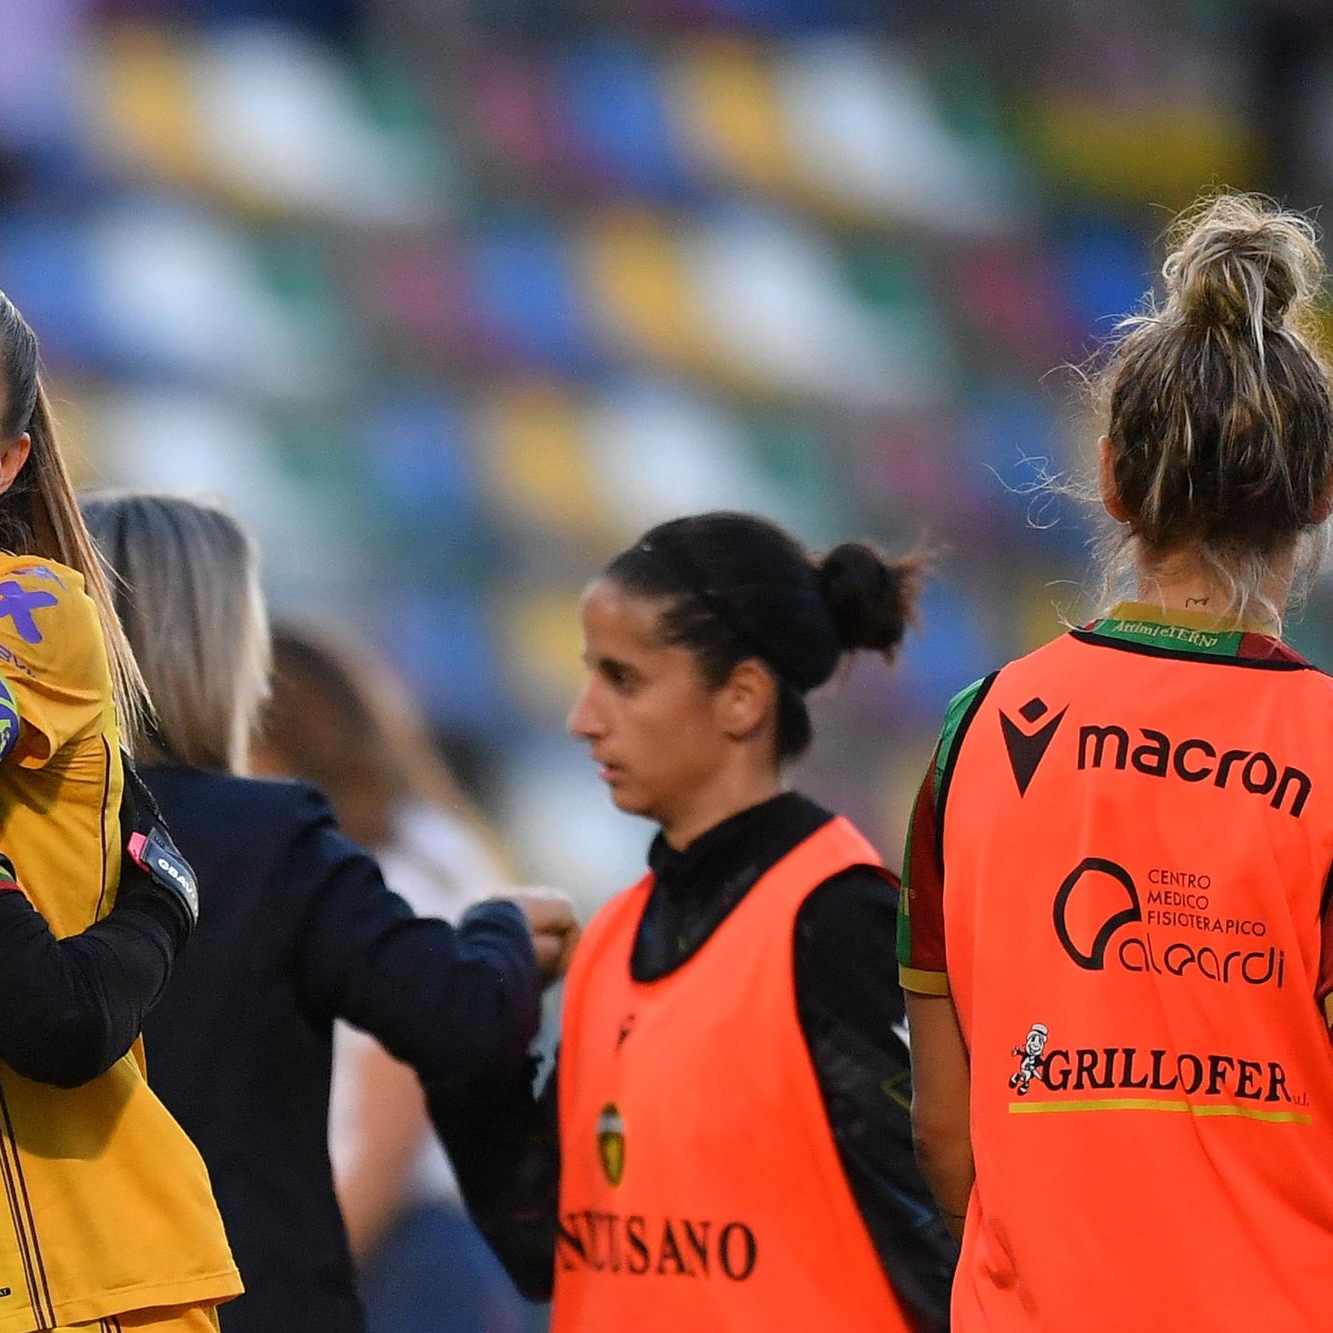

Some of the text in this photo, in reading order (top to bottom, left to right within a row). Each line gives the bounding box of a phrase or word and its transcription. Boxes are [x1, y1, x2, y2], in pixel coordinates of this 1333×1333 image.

[1076, 724, 1312, 818] macron
[1147, 868, 1211, 890] CENTRO
[1147, 890, 1209, 911] MEDICO
[1147, 910, 1266, 937] FISIOTERAPICO
[1118, 933, 1285, 989] aleardi
[1043, 1048, 1292, 1103] GRILLOFER
